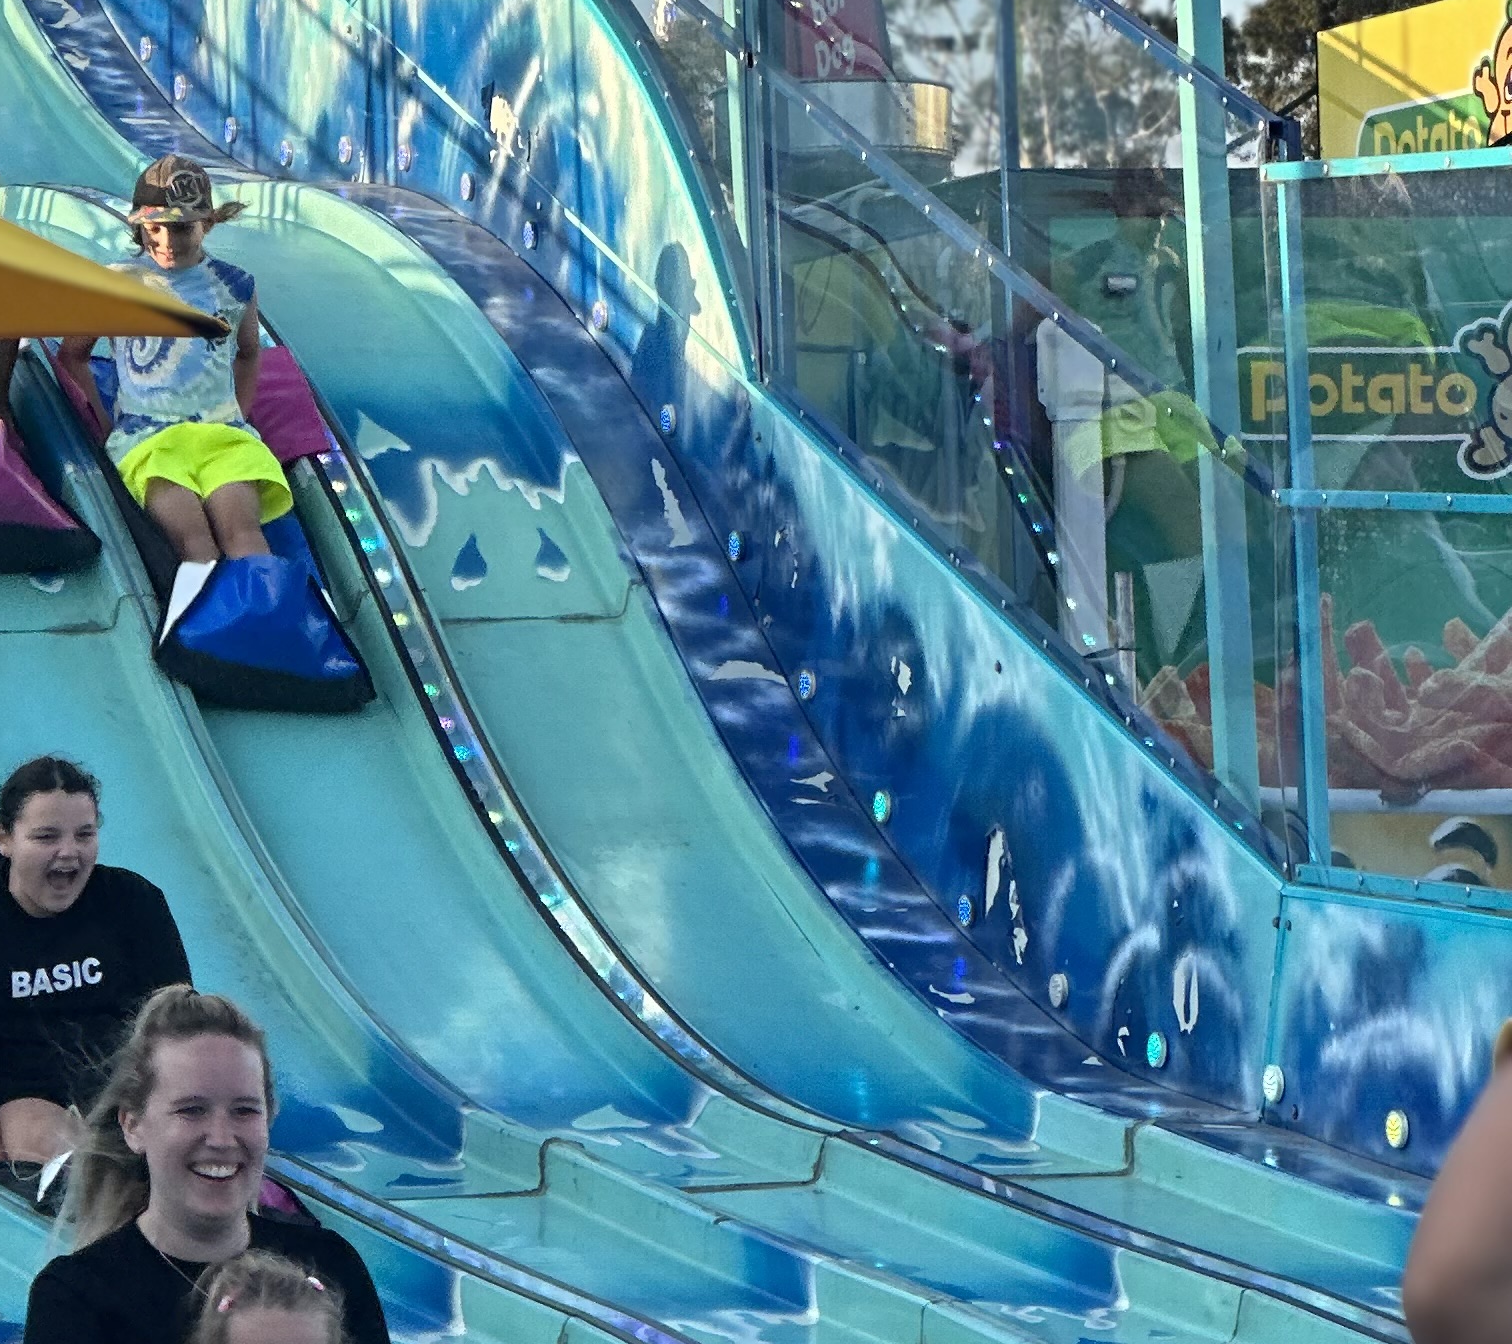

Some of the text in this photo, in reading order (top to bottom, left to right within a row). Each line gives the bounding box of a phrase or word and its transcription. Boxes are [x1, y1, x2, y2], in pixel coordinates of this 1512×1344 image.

[814, 32, 856, 77] Dog
[1250, 360, 1478, 421] Potato
[11, 957, 103, 998] BASIC
